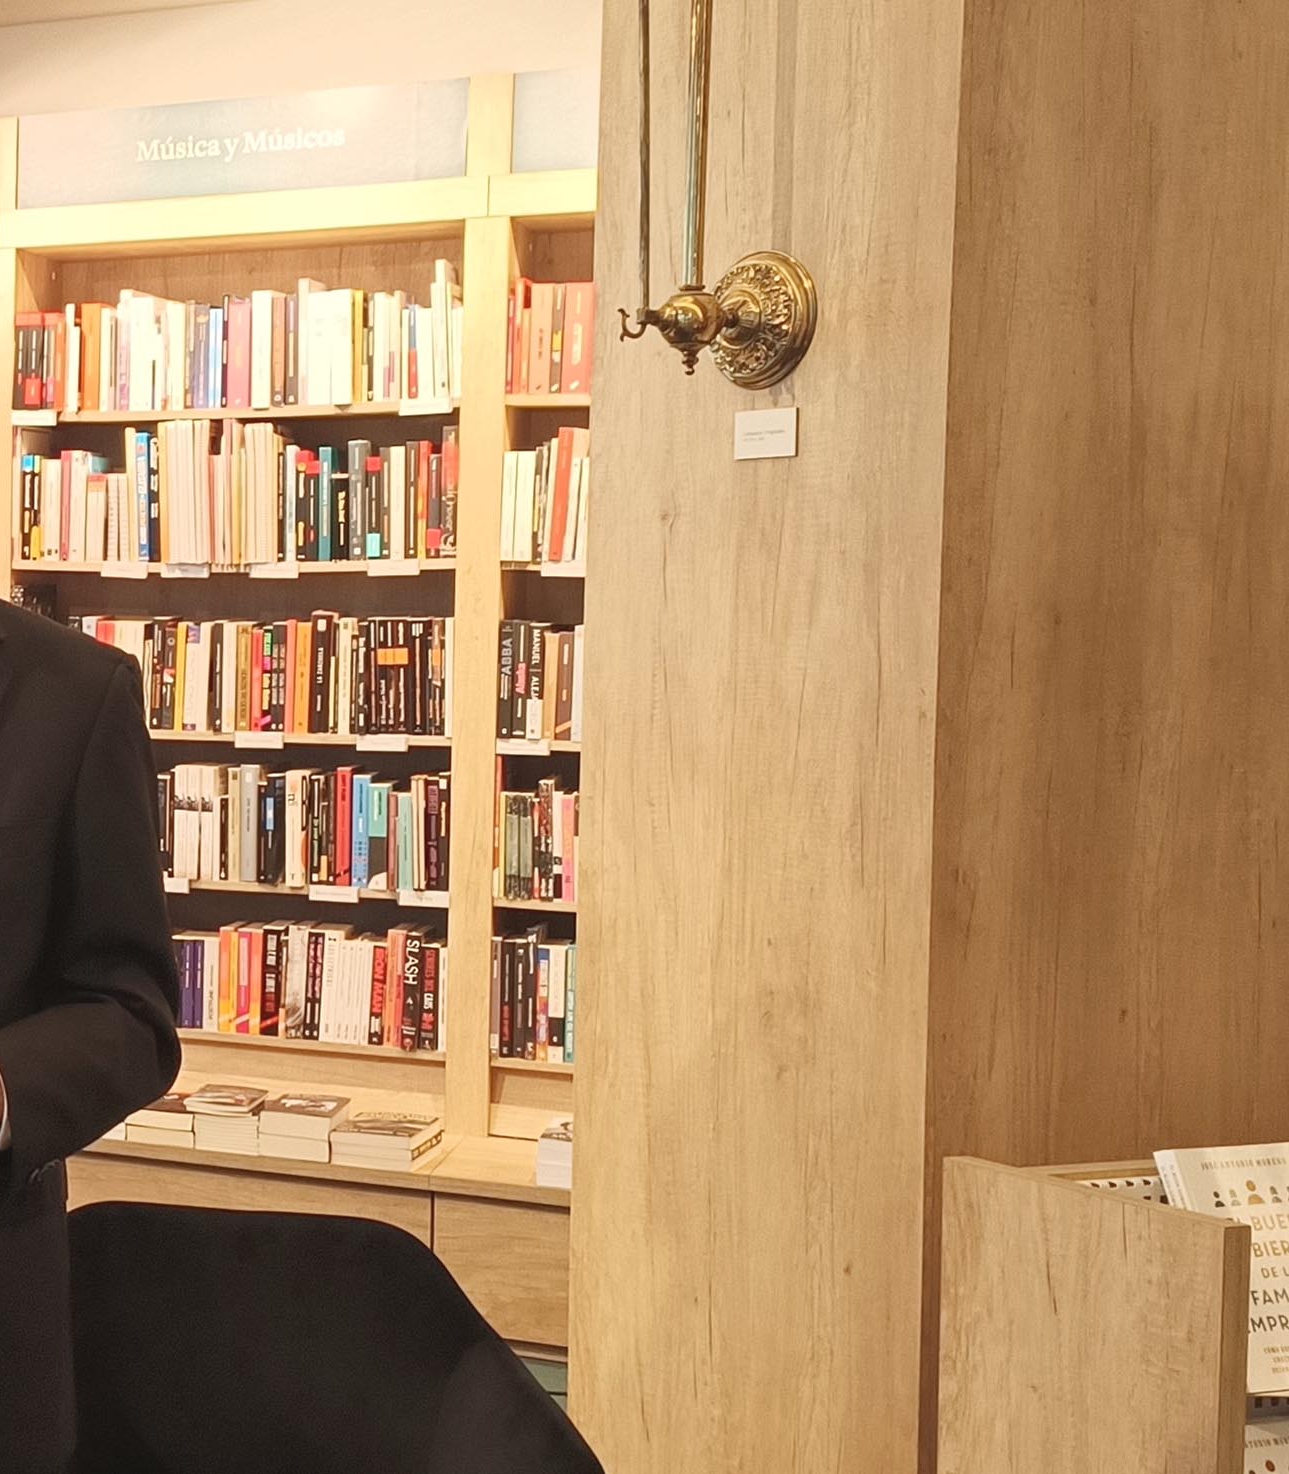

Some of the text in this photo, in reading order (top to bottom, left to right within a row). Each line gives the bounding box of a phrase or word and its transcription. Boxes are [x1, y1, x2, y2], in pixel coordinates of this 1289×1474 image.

[135, 124, 346, 163] Música y Músicos
[501, 638, 512, 675] ABBA
[532, 629, 541, 664] MANUEL
[404, 940, 420, 985] SLASH
[372, 981, 383, 1013] MAN
[1250, 1214, 1289, 1231] BUE
[1261, 1267, 1279, 1279] DE
